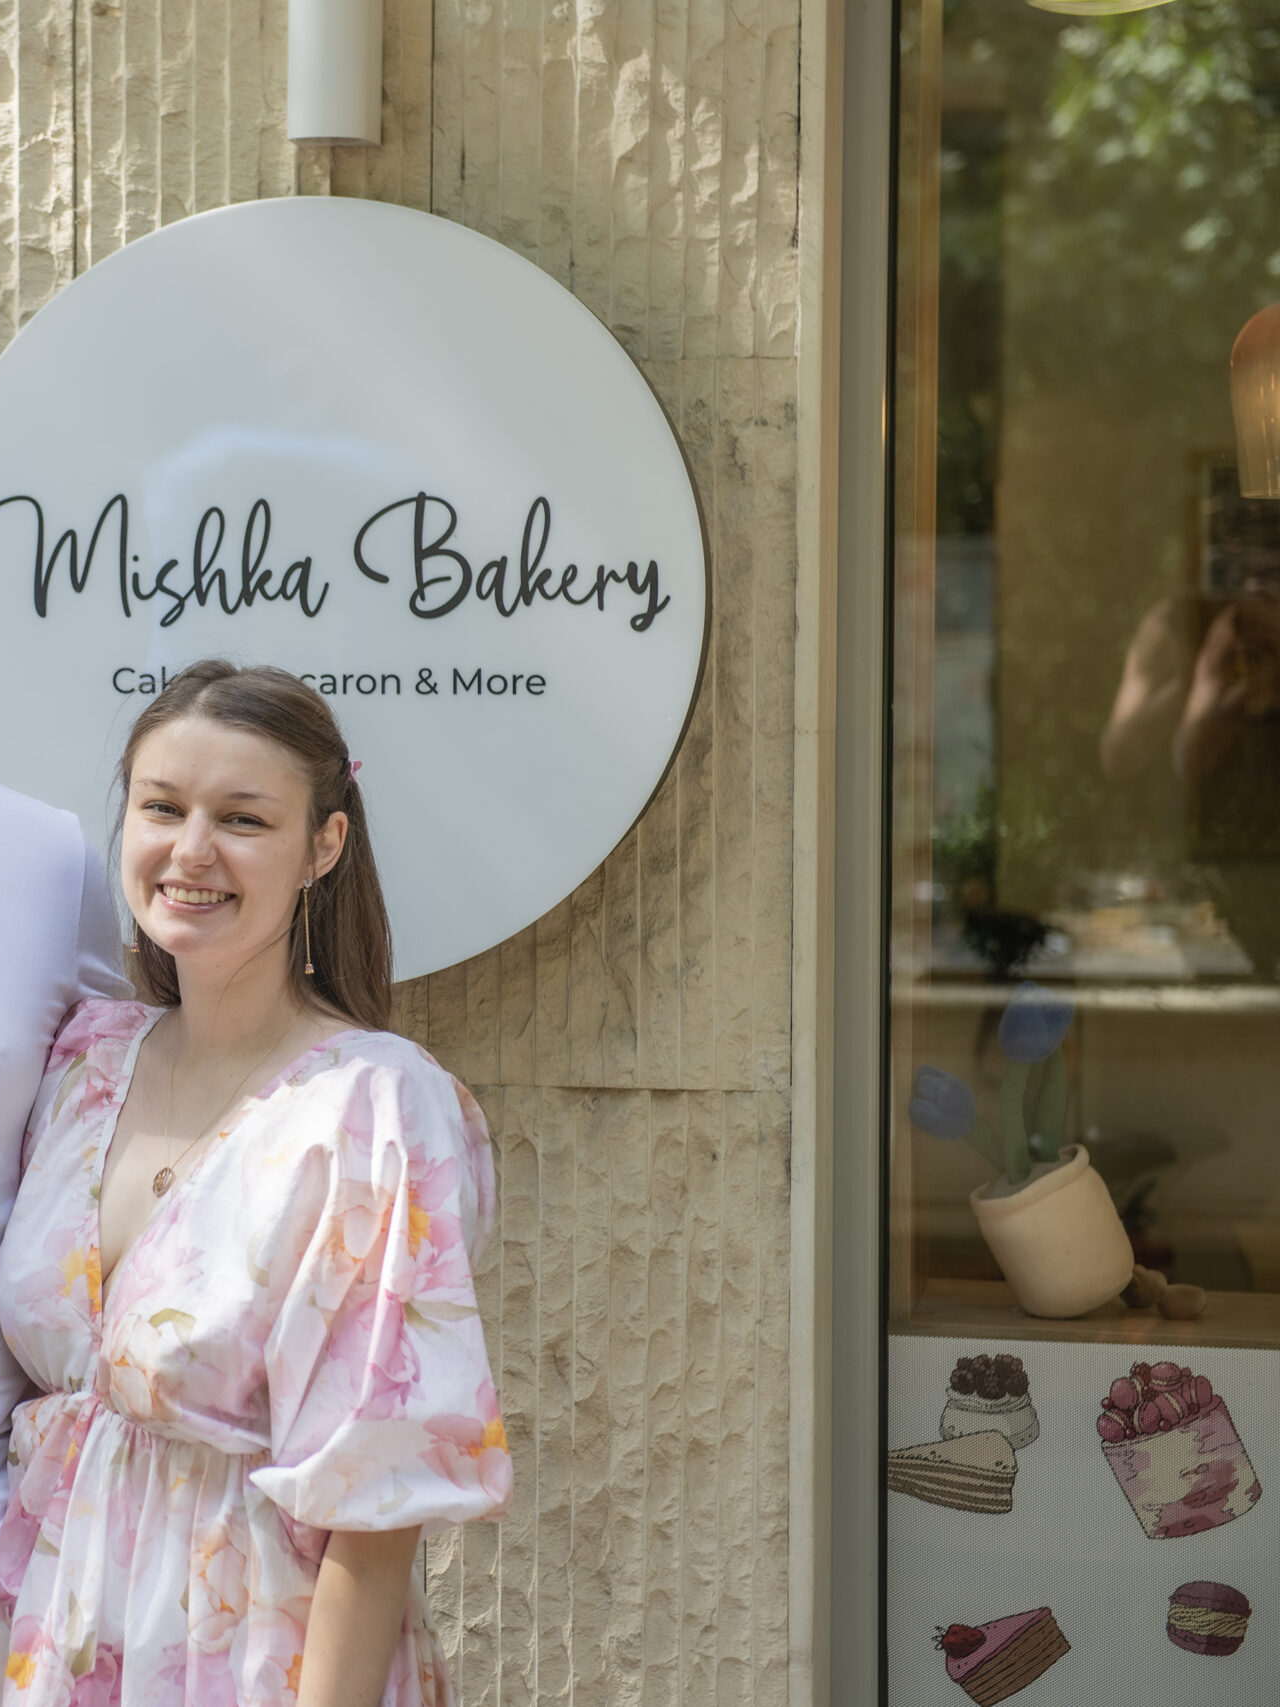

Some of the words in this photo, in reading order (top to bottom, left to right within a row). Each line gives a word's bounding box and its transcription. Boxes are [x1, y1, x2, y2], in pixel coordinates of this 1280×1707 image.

[353, 491, 671, 633] Bakery
[414, 667, 439, 696] &
[452, 667, 547, 696] More
